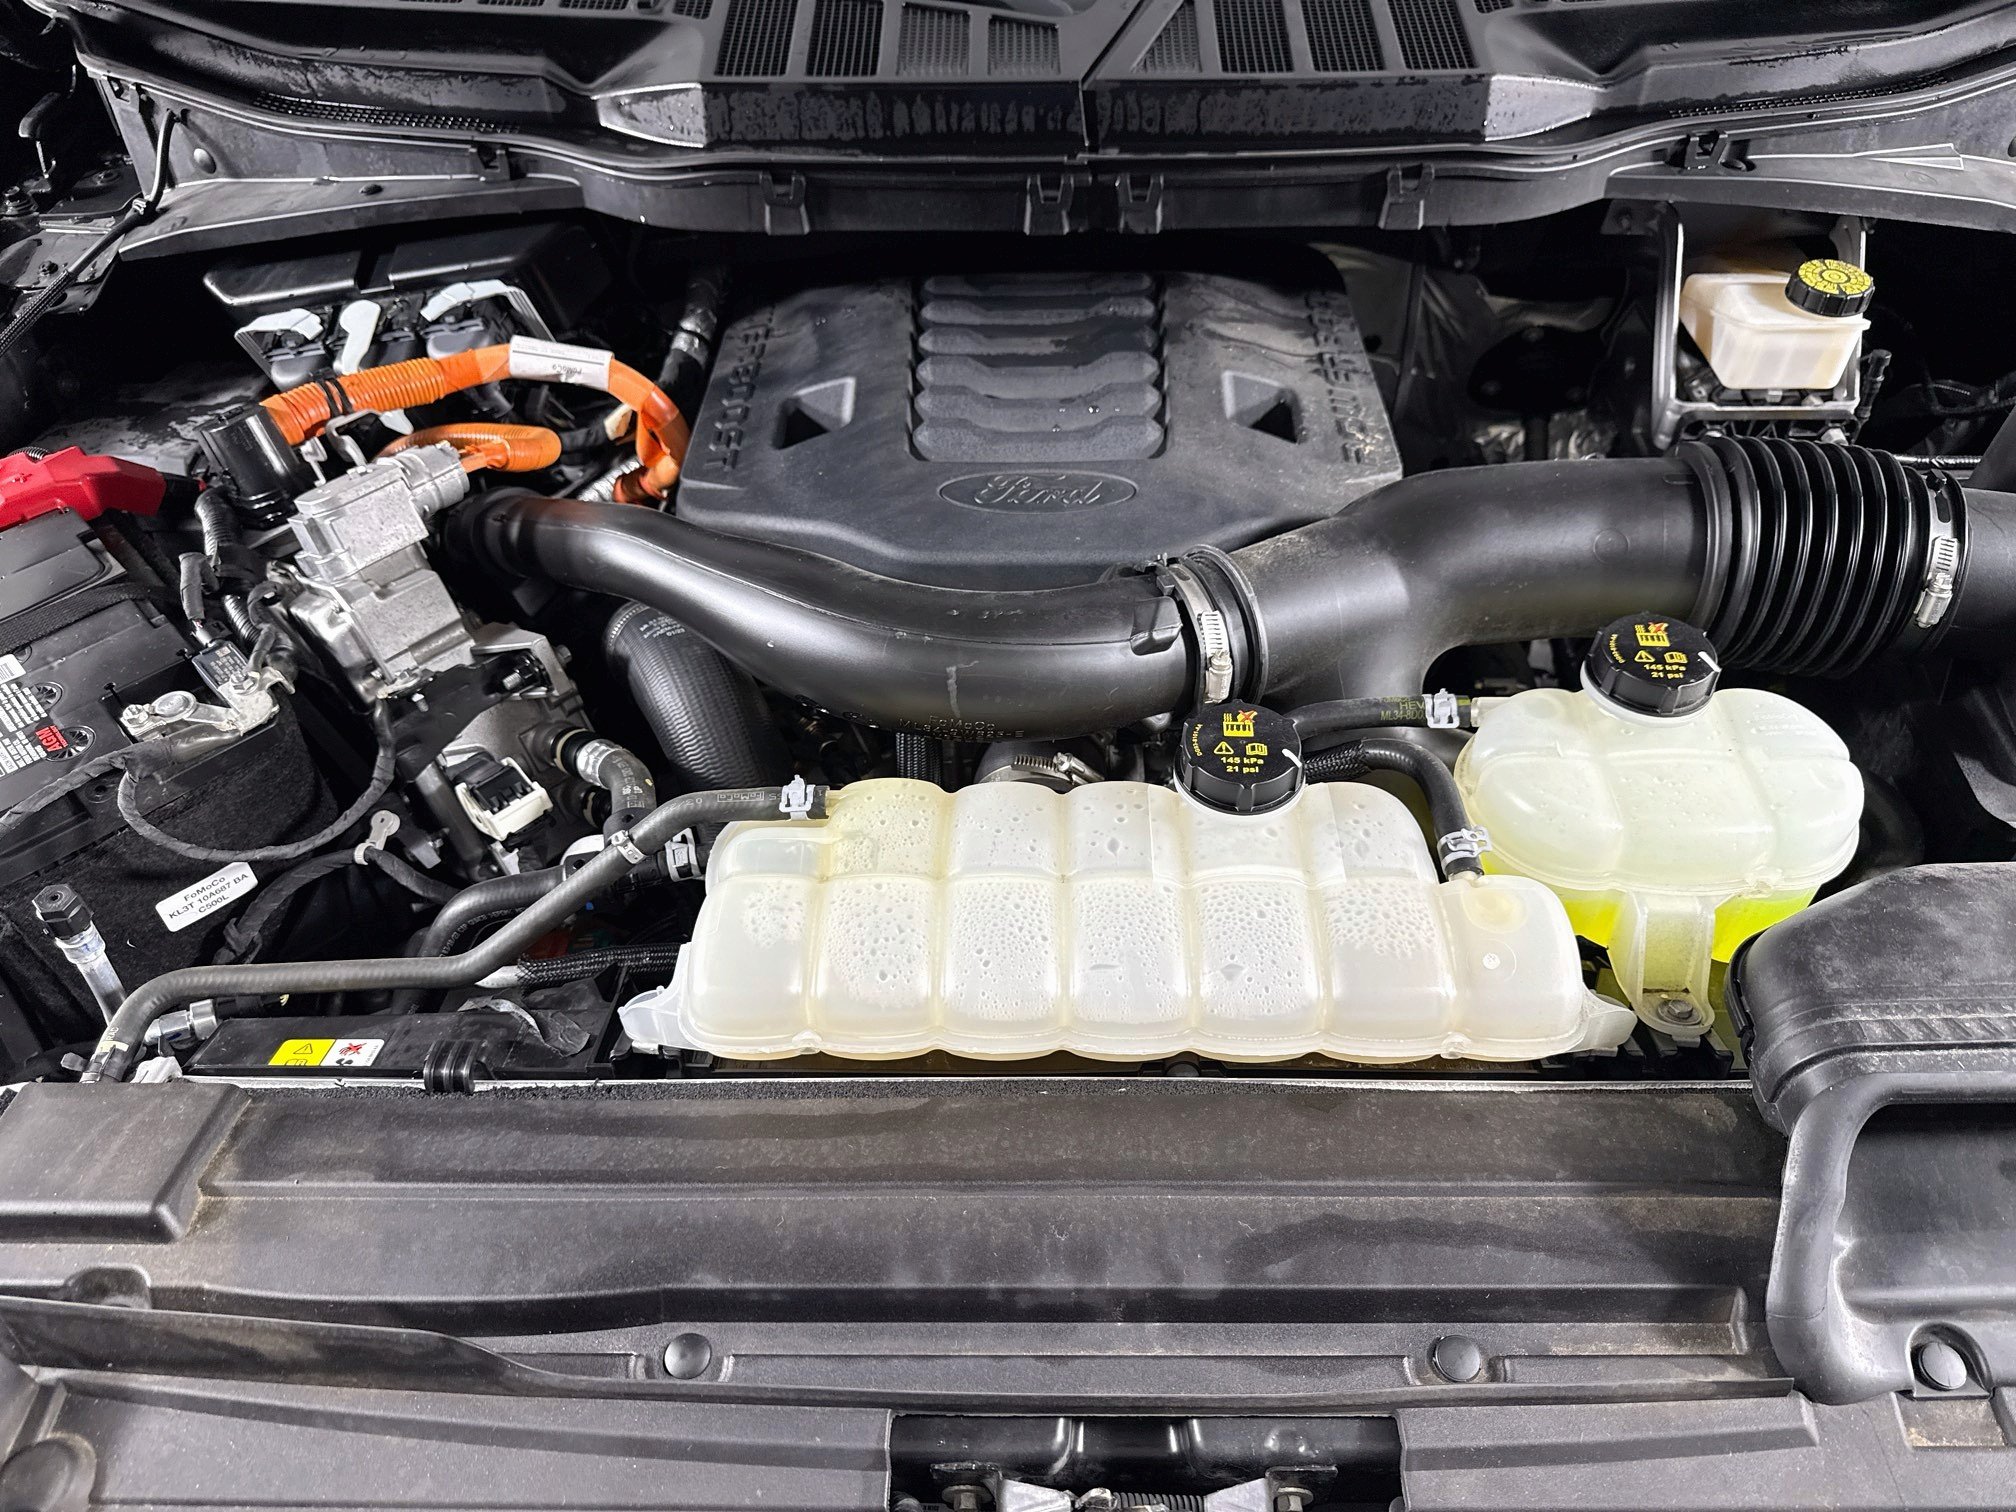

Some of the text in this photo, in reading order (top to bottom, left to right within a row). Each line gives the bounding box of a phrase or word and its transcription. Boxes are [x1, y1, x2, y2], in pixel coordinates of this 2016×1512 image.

[973, 475, 1102, 504] Ford
[1643, 663, 1664, 671] 145
[1667, 672, 1684, 680] psi
[36, 726, 63, 752] AGM
[1242, 766, 1259, 774] psi
[1243, 757, 1264, 765] kPa
[169, 902, 195, 919] KL3T
[233, 873, 249, 884] BA
[183, 877, 226, 901] FoMoCo
[198, 895, 230, 913] C500L
